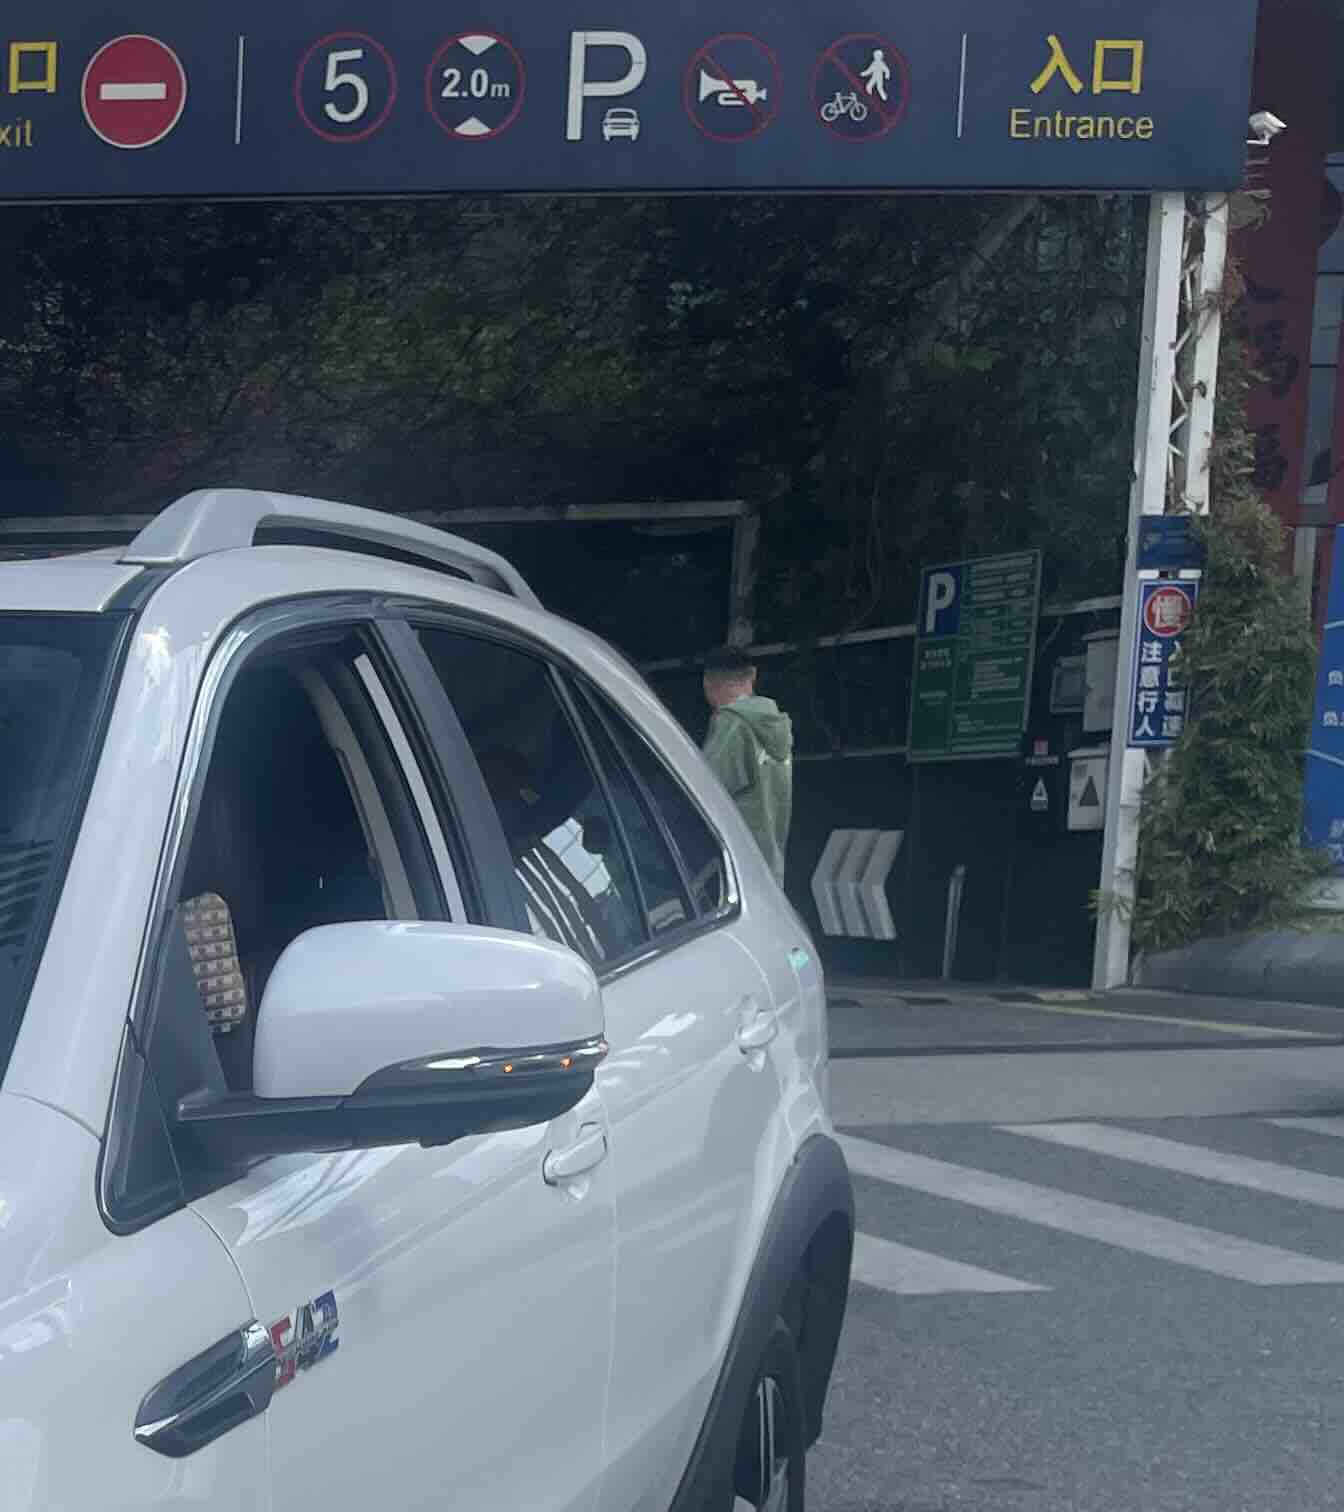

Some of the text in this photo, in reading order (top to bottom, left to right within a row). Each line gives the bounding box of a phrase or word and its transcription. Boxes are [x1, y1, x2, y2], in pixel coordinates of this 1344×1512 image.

[324, 48, 369, 124] 5
[441, 67, 511, 99] 2.0m
[566, 31, 647, 141] P
[1030, 34, 1143, 95] 入口
[1010, 108, 1154, 139] Entrance
[925, 572, 957, 633] P
